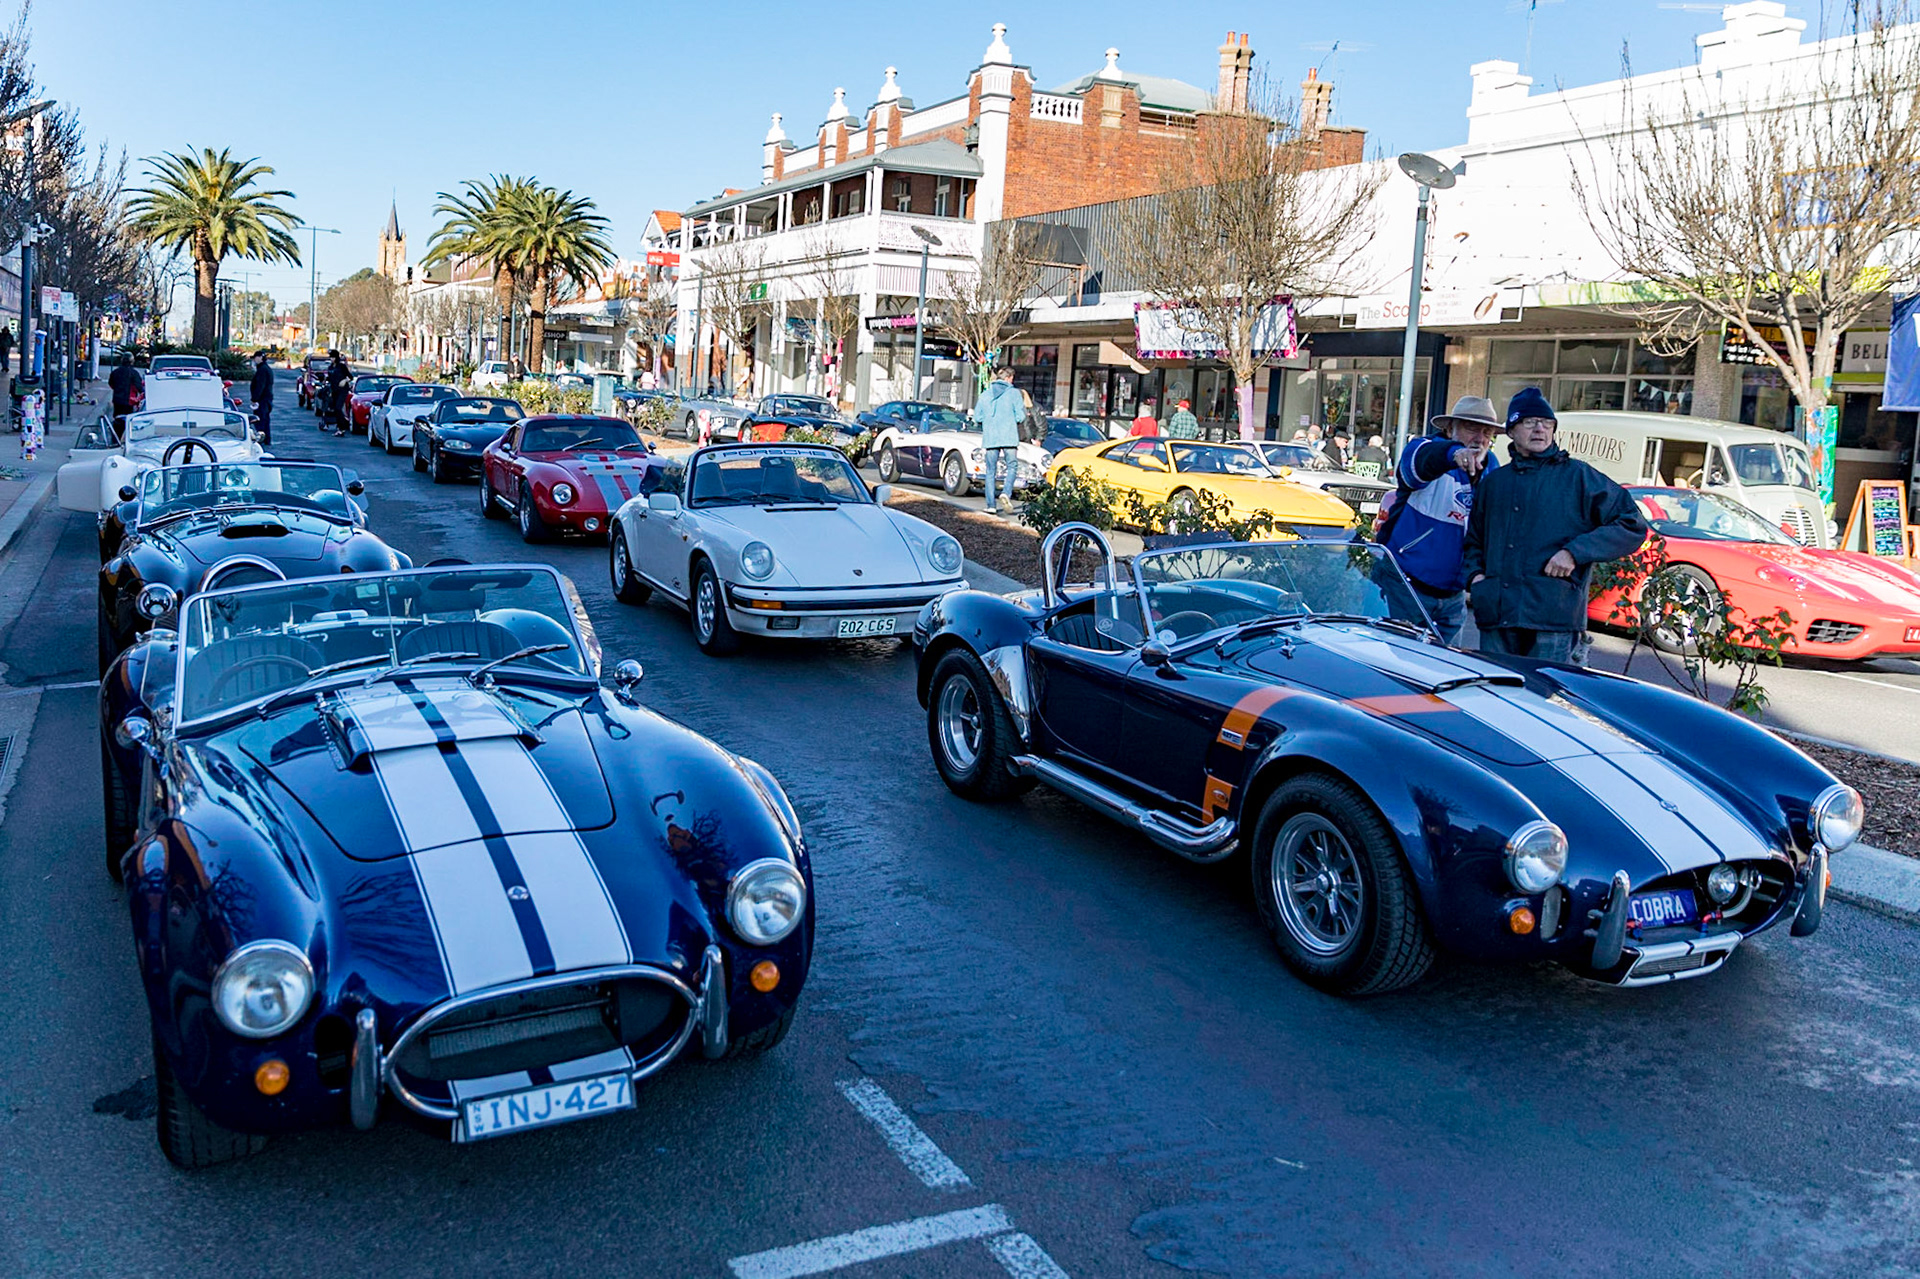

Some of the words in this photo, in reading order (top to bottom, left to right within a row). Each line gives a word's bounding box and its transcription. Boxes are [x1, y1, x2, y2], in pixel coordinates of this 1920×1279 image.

[1360, 306, 1381, 320] The
[1383, 300, 1431, 325] Scop
[722, 449, 827, 458] PORSCHE
[1568, 431, 1626, 462] MOTORS
[1631, 895, 1687, 922] COBRA
